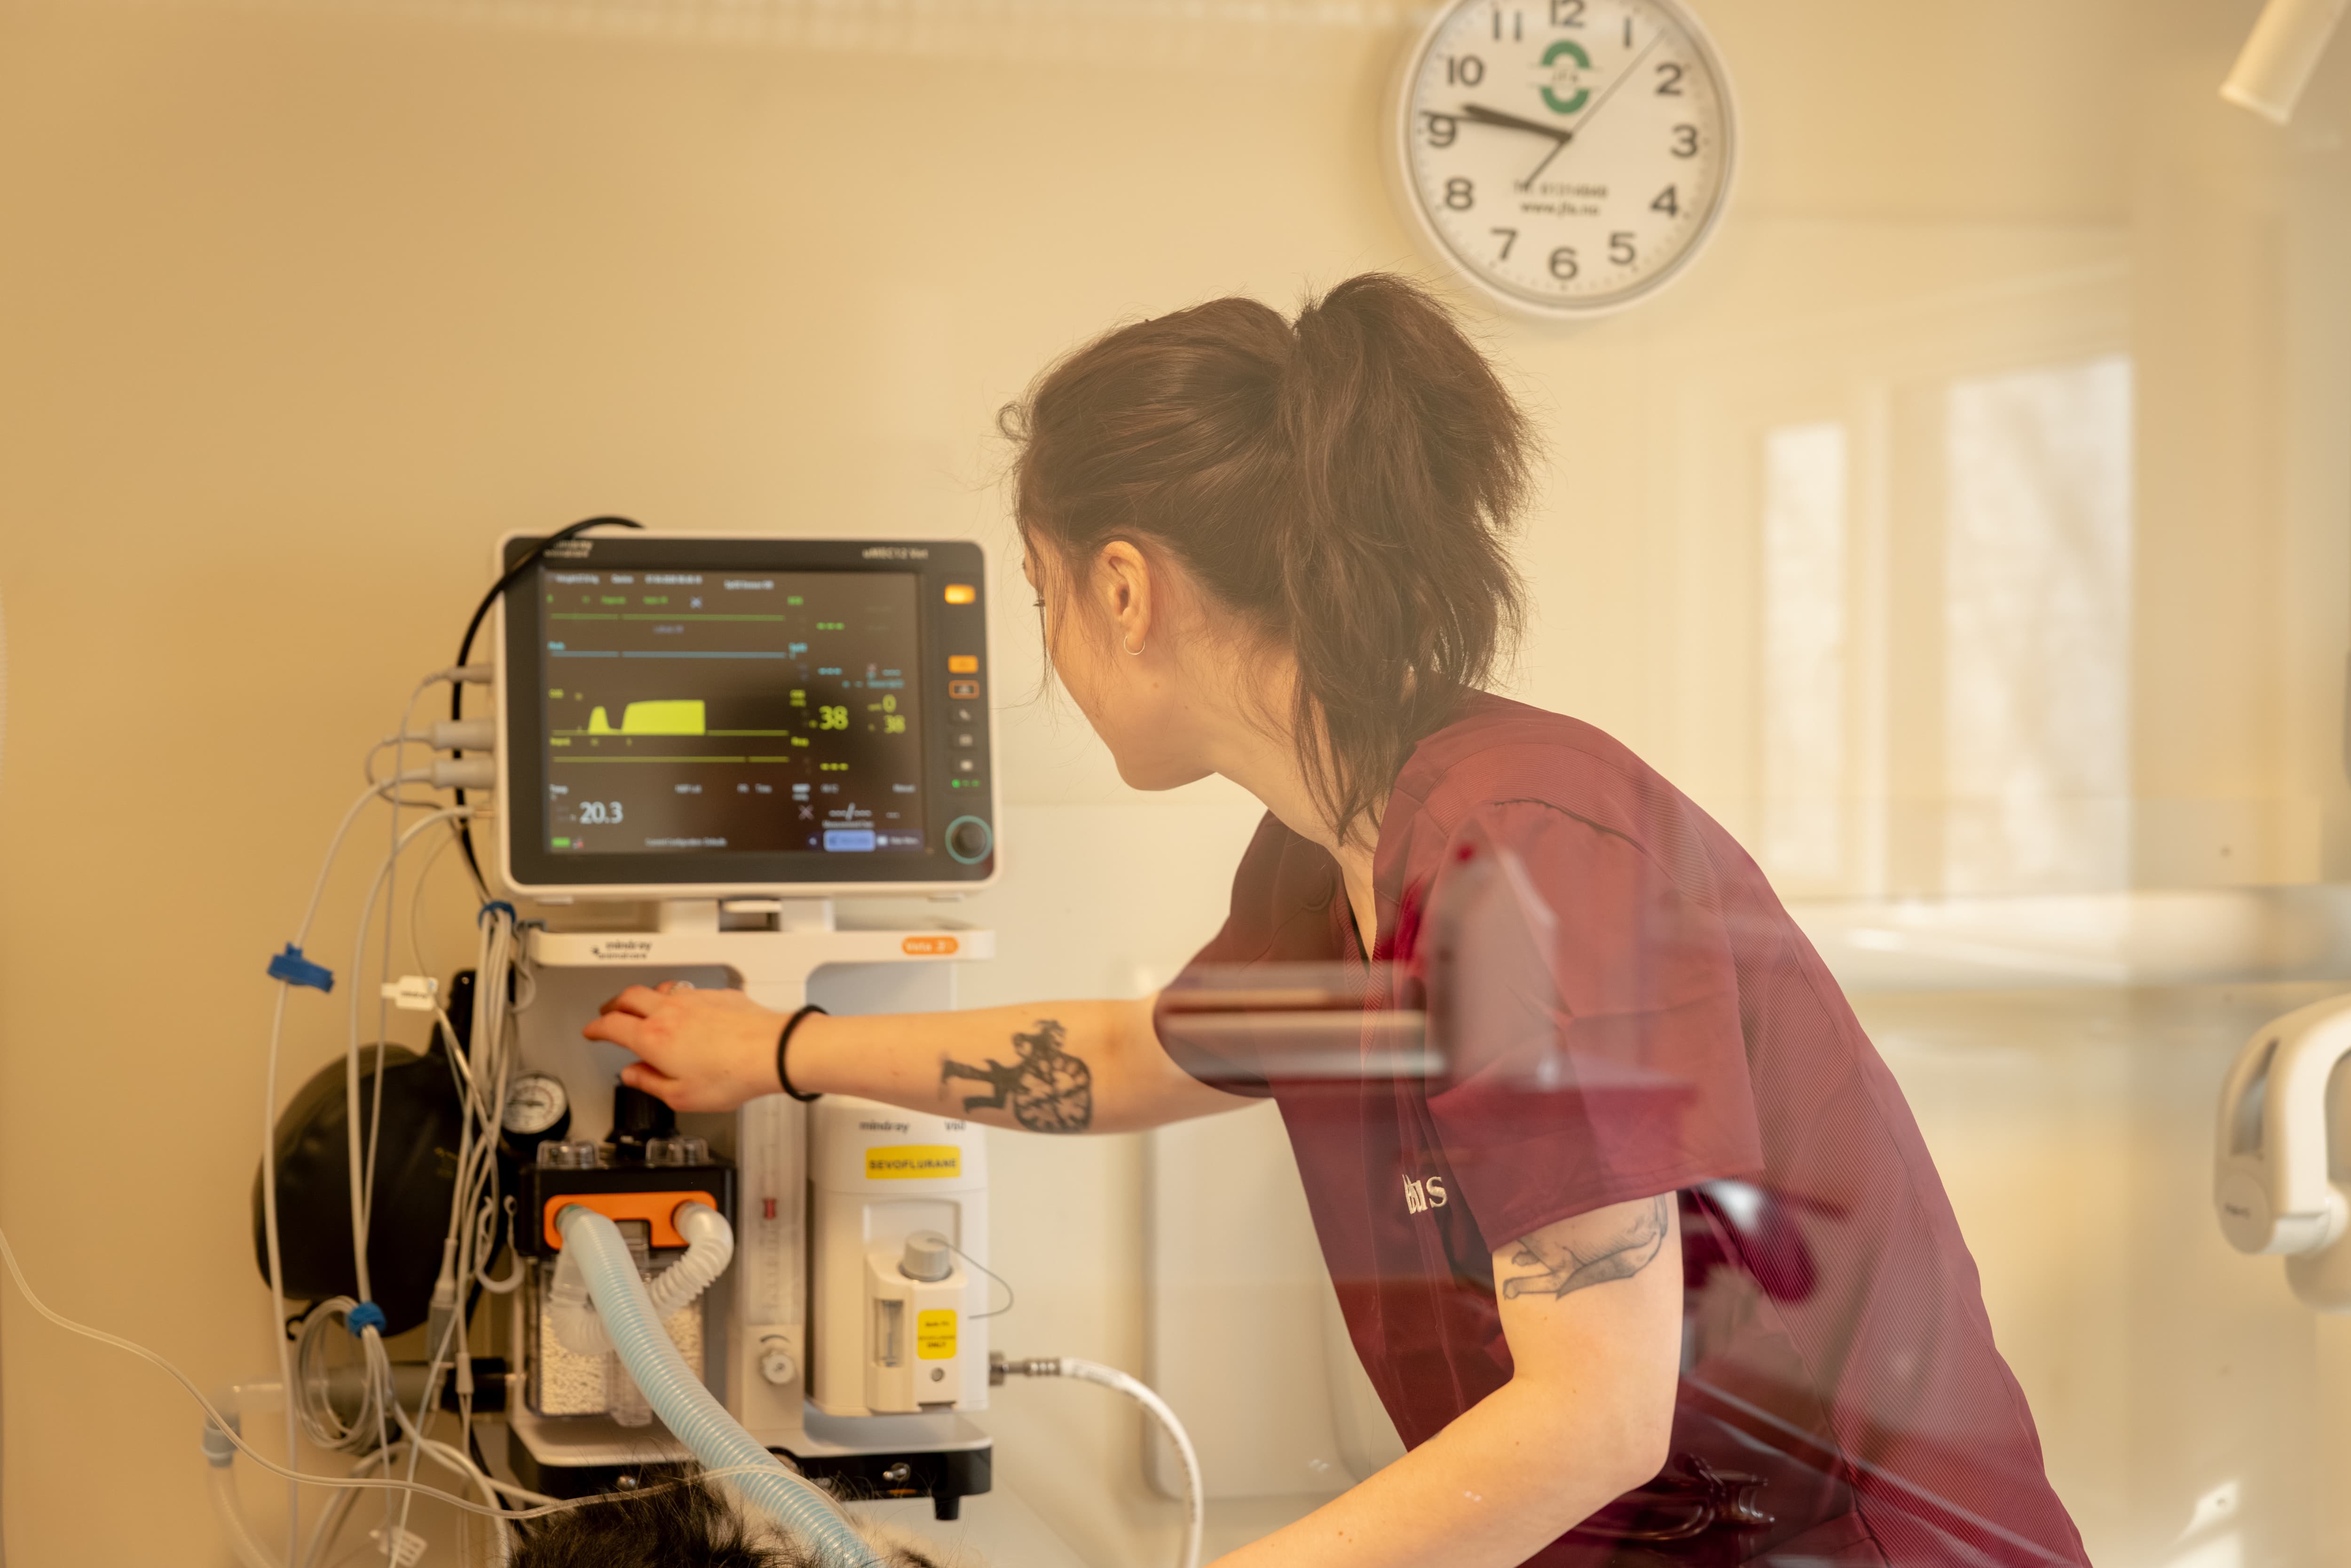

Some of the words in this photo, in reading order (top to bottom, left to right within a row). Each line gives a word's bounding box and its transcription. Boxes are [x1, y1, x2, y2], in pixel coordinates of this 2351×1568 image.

[1493, 8, 1522, 41] 11
[1550, 0, 1586, 27] 12
[1624, 17, 1632, 48] 1
[1447, 55, 1484, 86] 10
[1655, 63, 1683, 95] 2
[1428, 116, 1457, 148] 9
[1671, 125, 1698, 158] 3
[1445, 178, 1475, 211] 8
[1650, 185, 1678, 218] 4
[1491, 228, 1518, 261] 7
[1609, 232, 1636, 265] 5
[1550, 248, 1578, 280] 6
[819, 706, 848, 730] 38
[579, 801, 623, 824] 20.3
